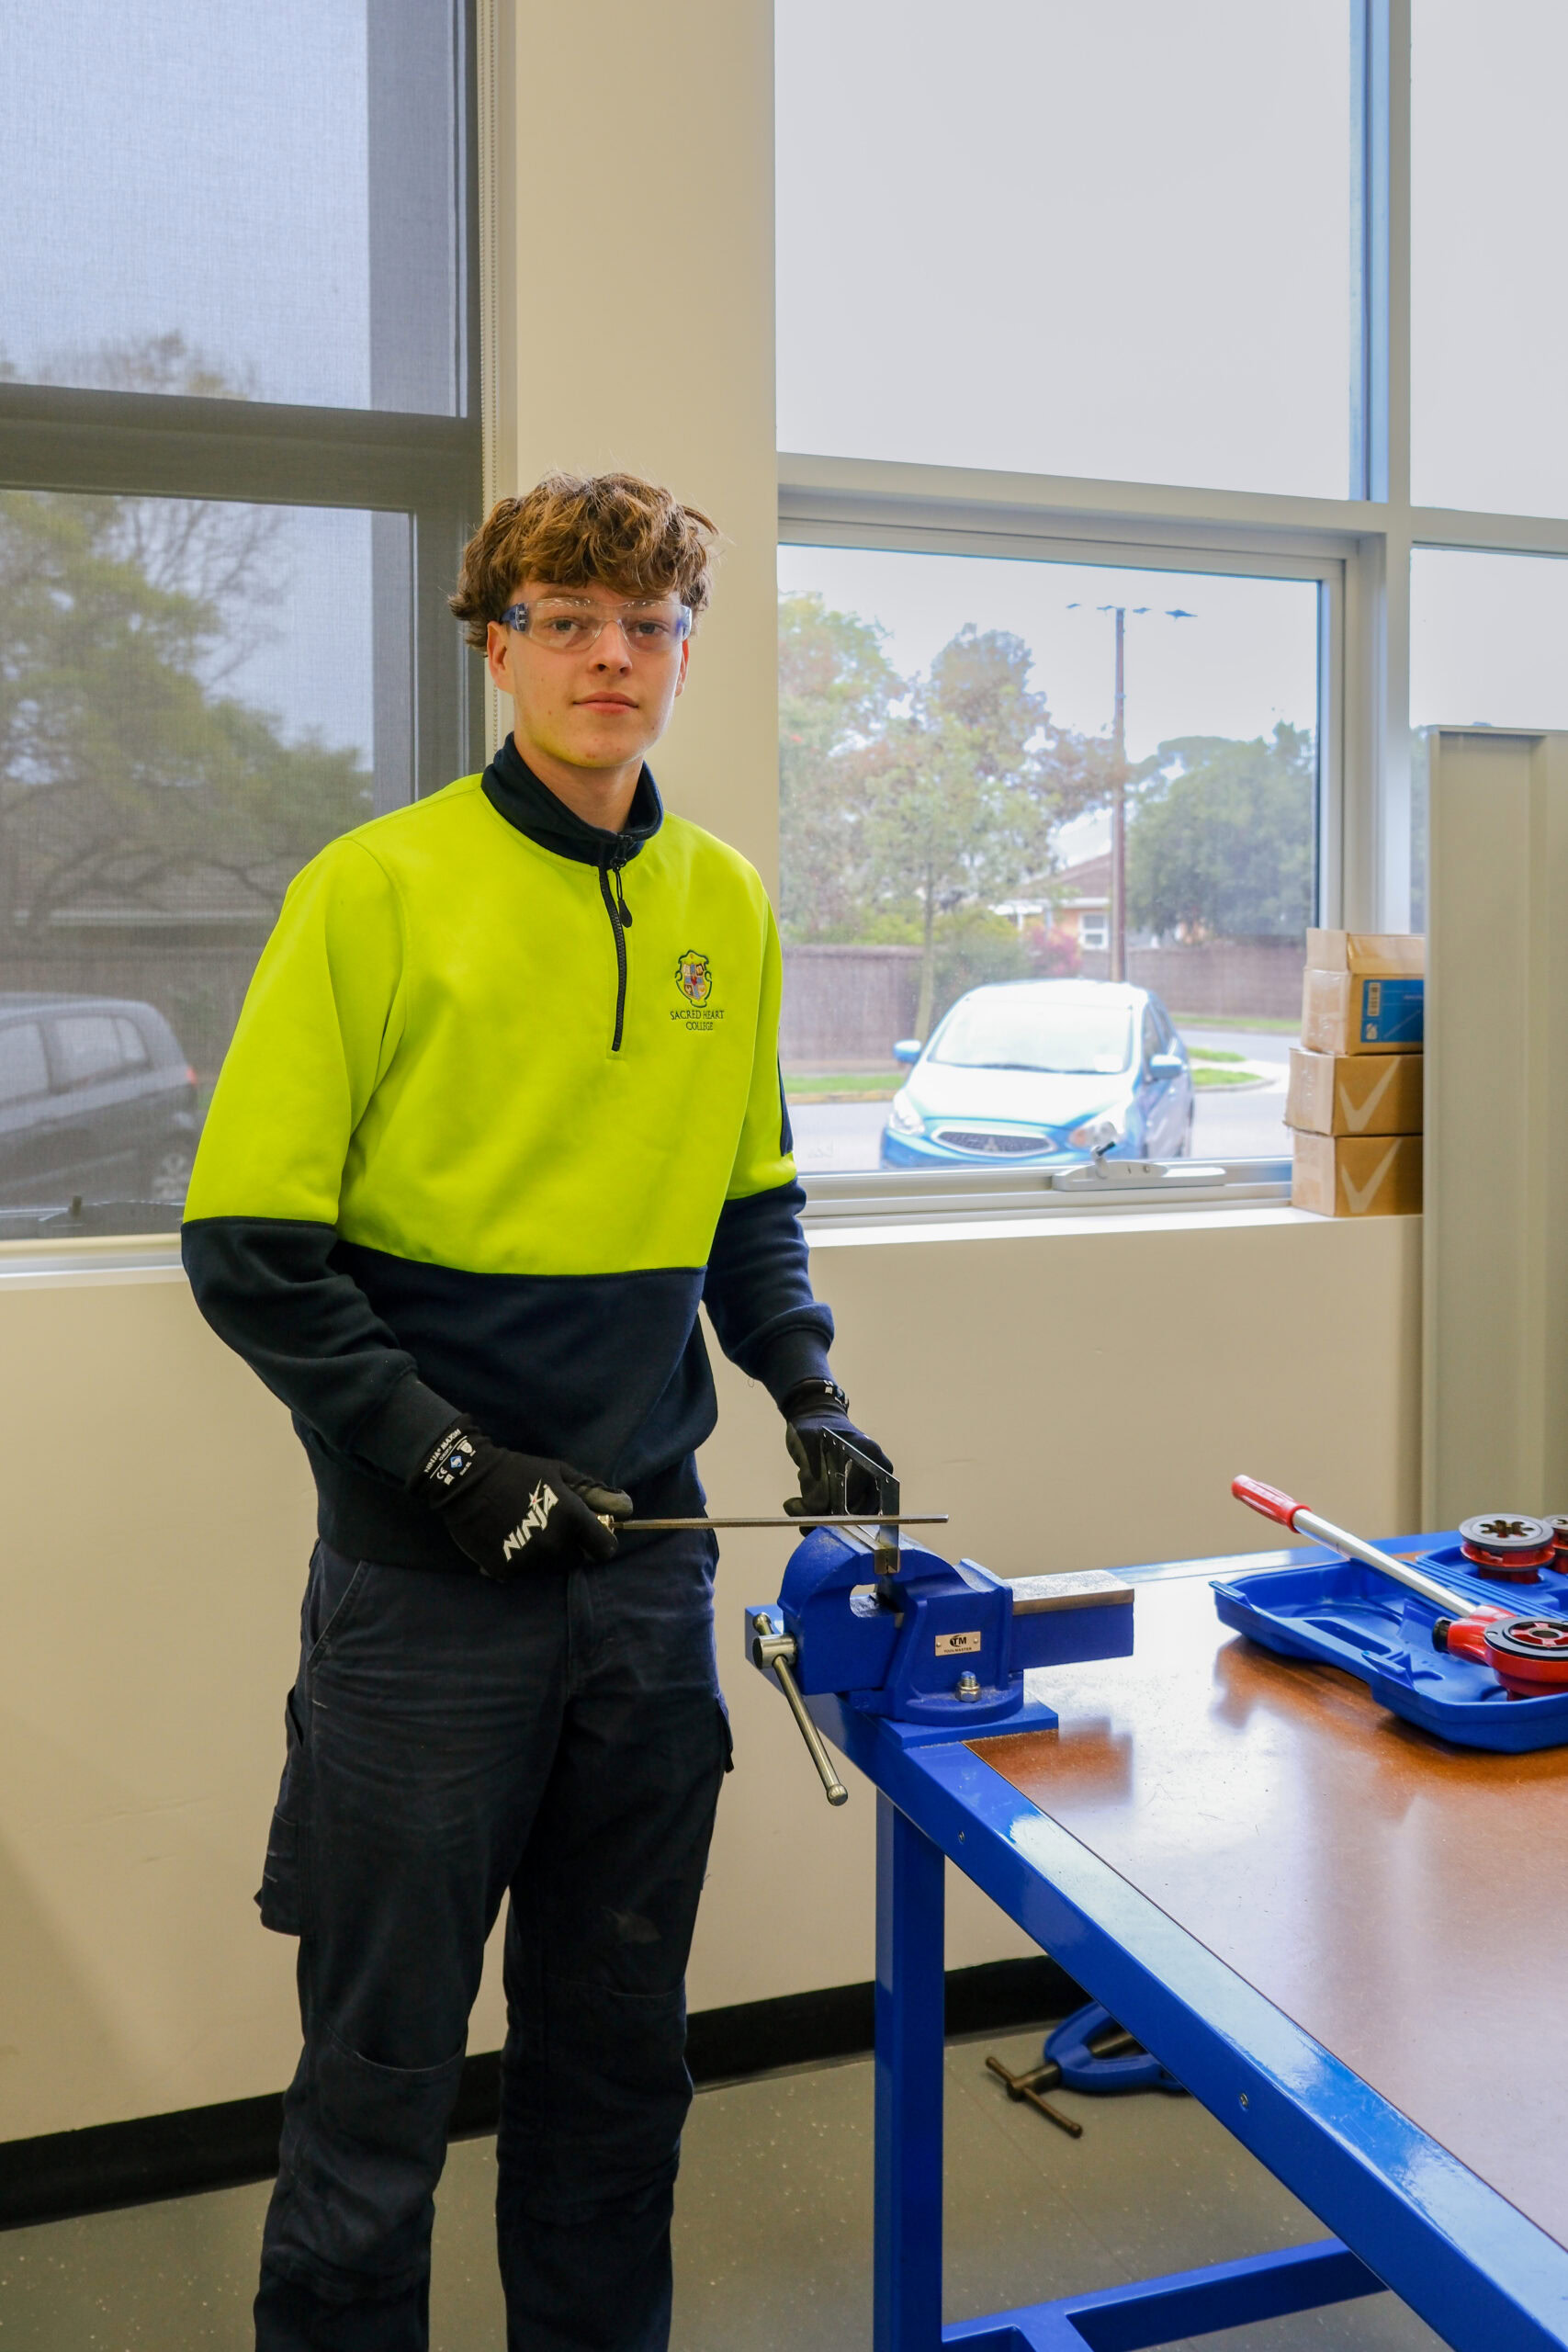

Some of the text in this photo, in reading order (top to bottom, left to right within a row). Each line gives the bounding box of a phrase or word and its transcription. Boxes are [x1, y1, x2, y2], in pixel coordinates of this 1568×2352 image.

[670, 1010, 725, 1021] SACRED HEART
[685, 1021, 714, 1031] COLLEGE
[502, 1477, 558, 1562] NINJA
